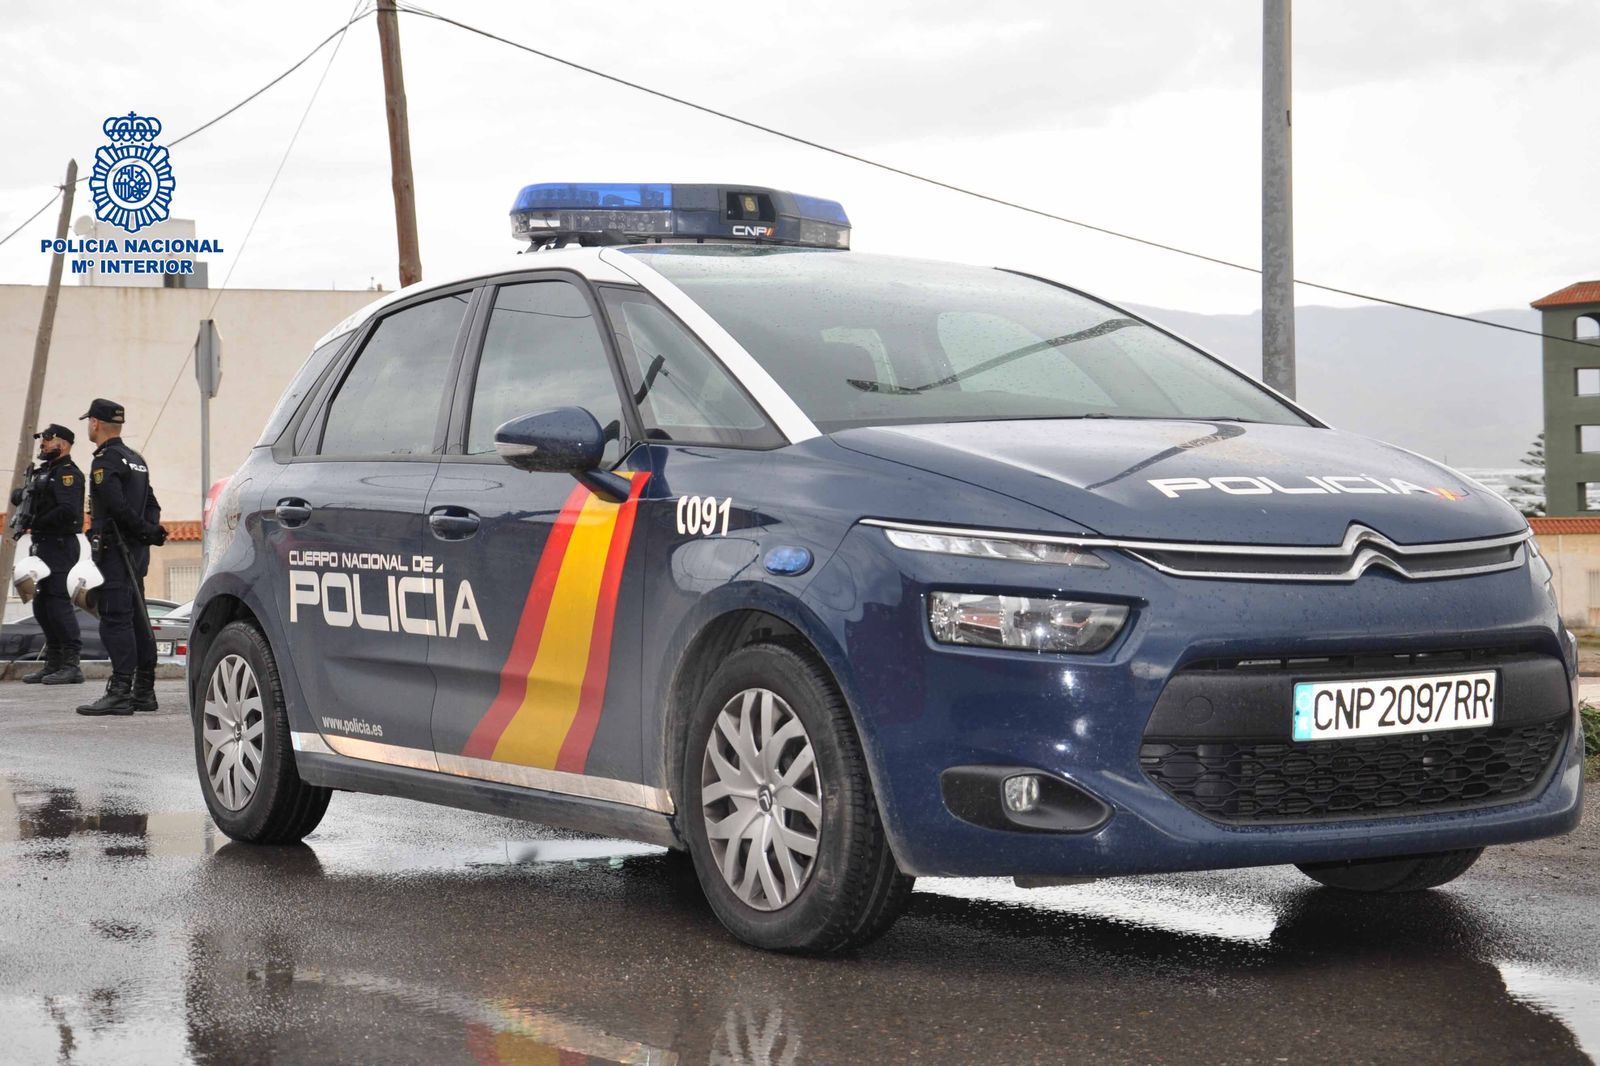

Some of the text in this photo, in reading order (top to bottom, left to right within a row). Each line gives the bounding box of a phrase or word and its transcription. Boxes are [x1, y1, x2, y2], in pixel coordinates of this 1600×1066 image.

[732, 225, 767, 236] CNP
[289, 551, 433, 573] CUERPO NACIONAL DE
[322, 716, 383, 736] www.policia.es
